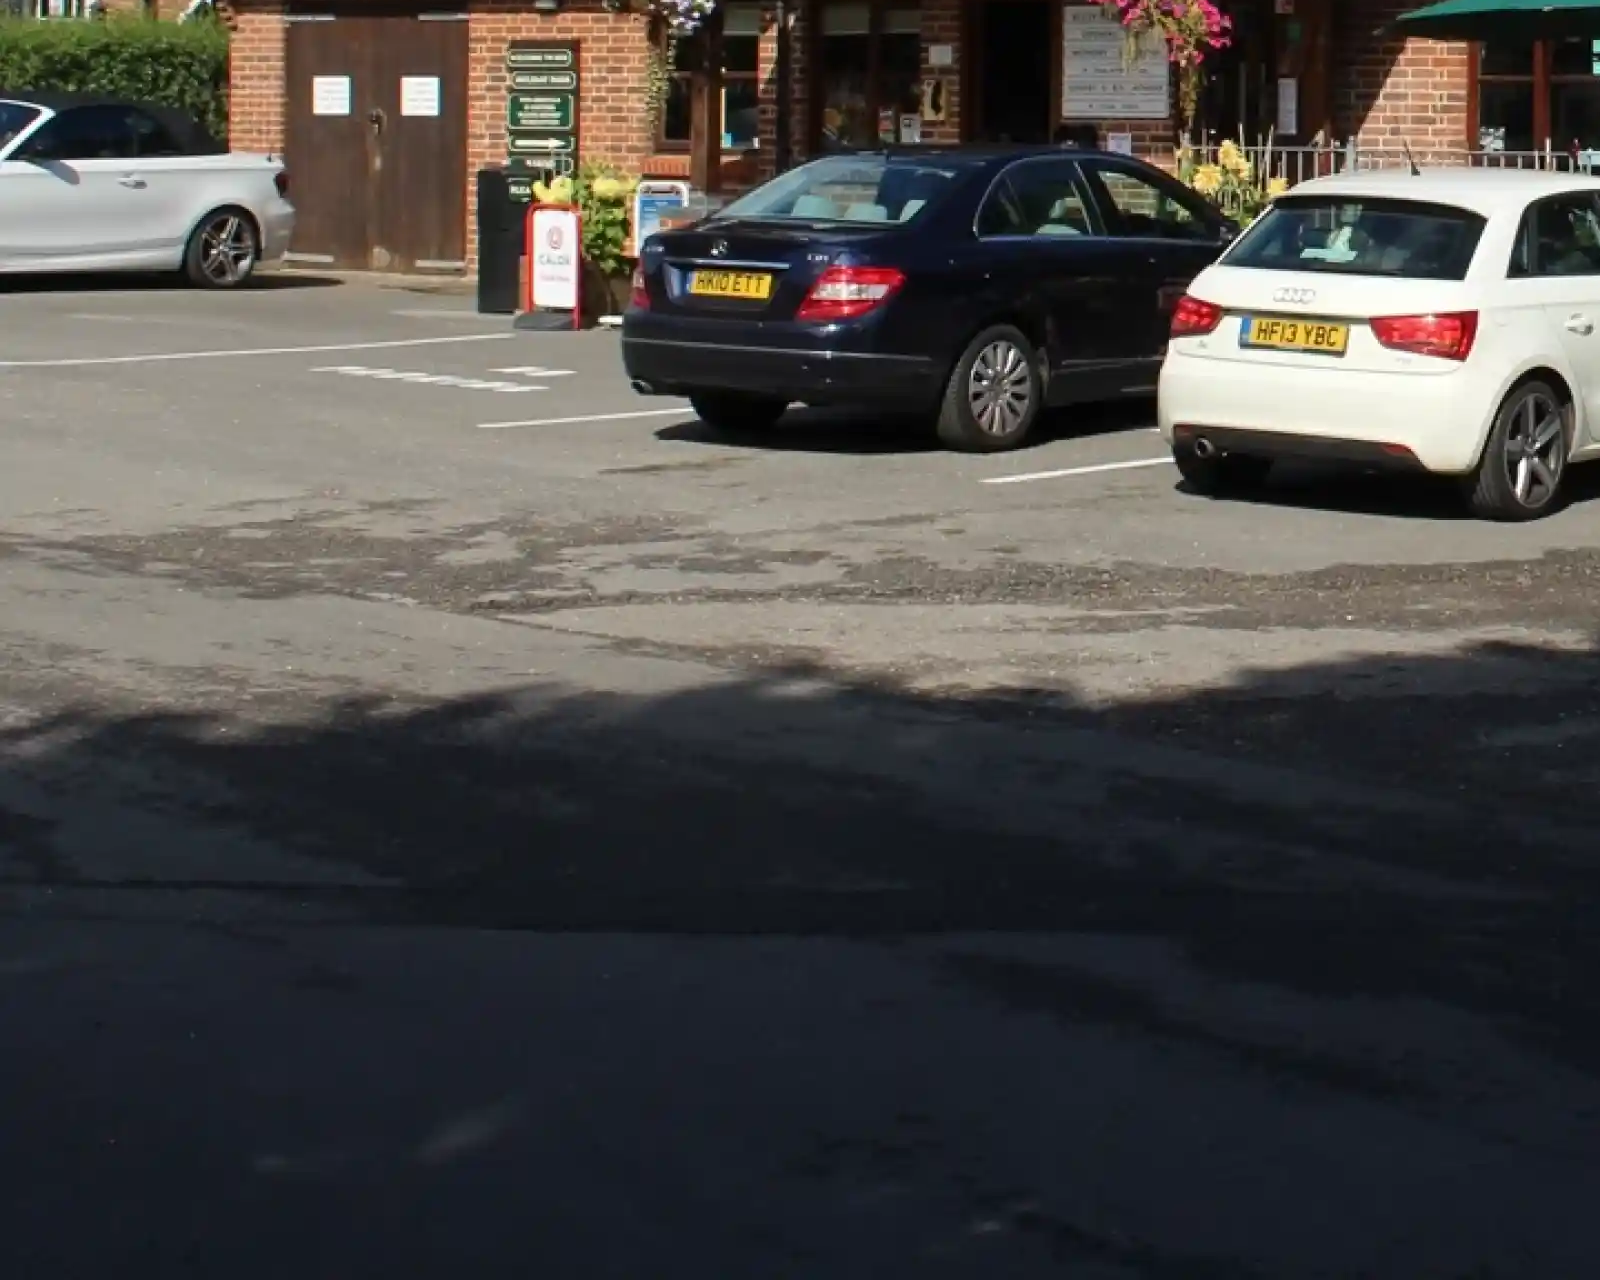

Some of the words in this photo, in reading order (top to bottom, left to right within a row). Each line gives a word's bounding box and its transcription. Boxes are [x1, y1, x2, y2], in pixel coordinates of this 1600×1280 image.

[696, 273, 729, 291] HK10
[733, 275, 765, 294] ETT
[1256, 321, 1298, 343] HF13
[1303, 324, 1339, 347] YBC
